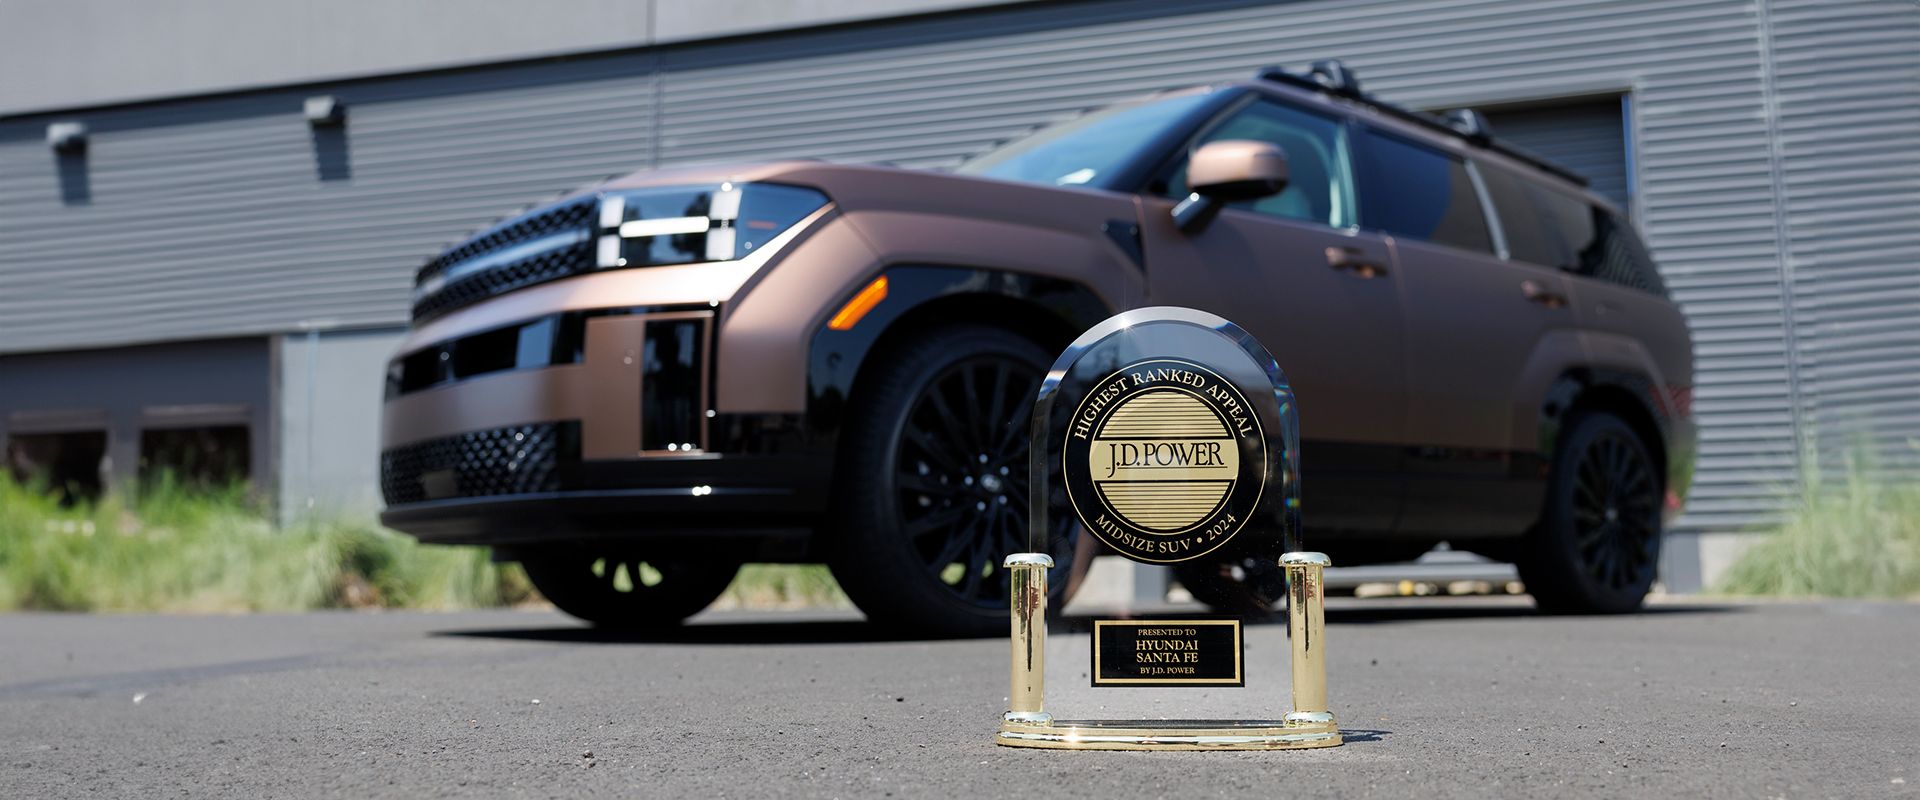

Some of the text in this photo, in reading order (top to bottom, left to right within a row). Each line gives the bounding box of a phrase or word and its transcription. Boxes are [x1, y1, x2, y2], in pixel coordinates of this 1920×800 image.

[1074, 368, 1253, 440] HIGHEST RANKED APPEAL
[1107, 442, 1224, 478] J.D. POWER
[1095, 513, 1237, 553] MIDSIZE SUV 2024
[1136, 640, 1198, 650] HYUNDAI
[1136, 652, 1199, 663] SANTA FE
